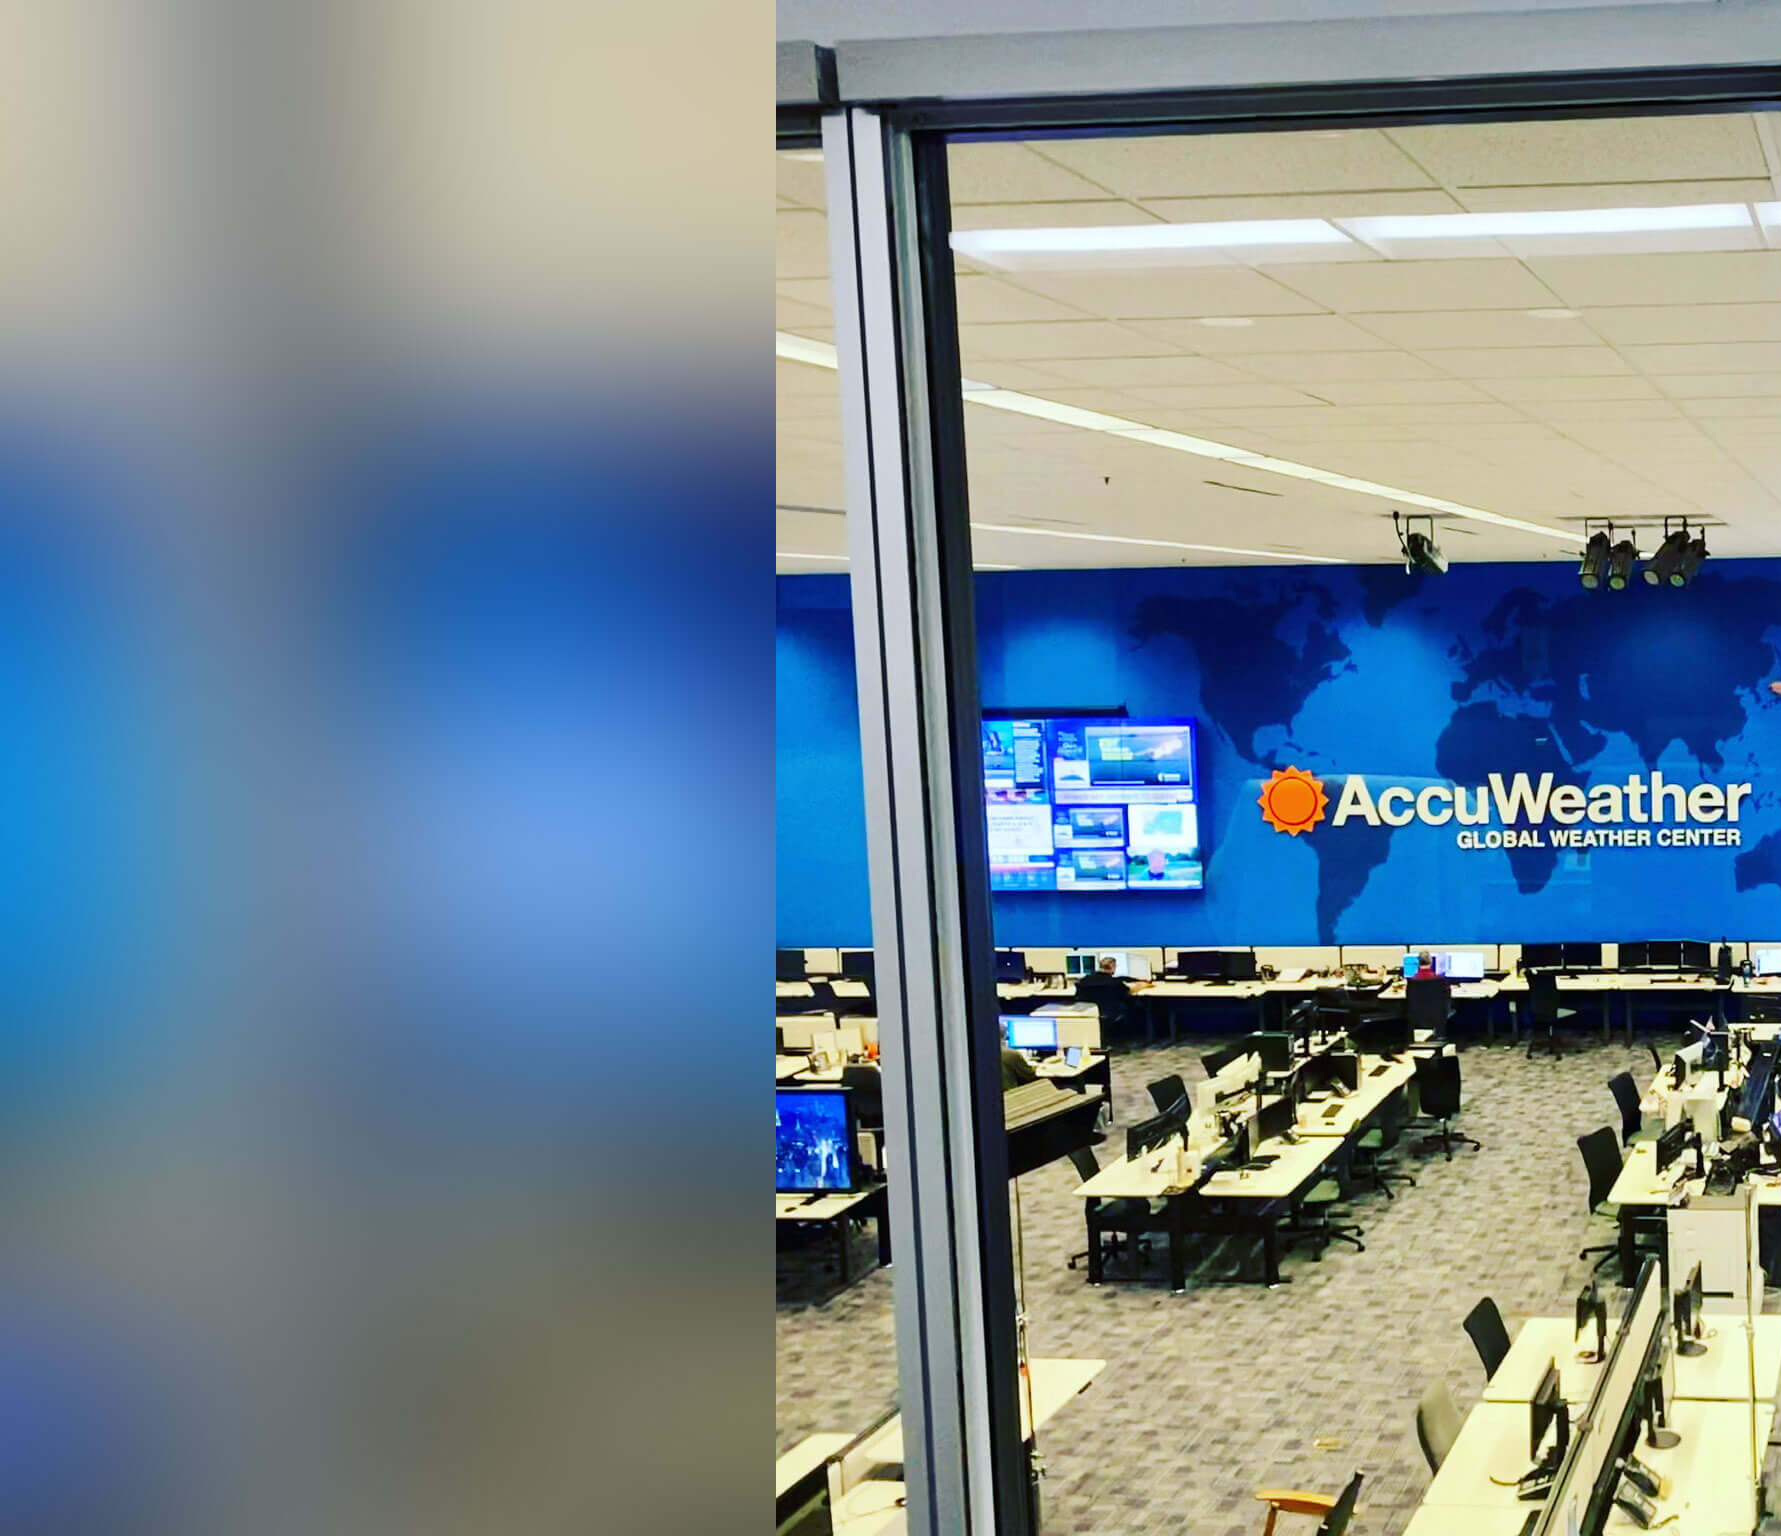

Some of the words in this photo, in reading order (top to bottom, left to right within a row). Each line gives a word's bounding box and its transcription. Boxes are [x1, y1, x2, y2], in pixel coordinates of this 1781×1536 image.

[1331, 771, 1753, 827] AccuWeather
[1456, 830, 1546, 850] GLOBAL
[1549, 829, 1651, 849] WEATHER
[1656, 828, 1741, 848] CENTER
